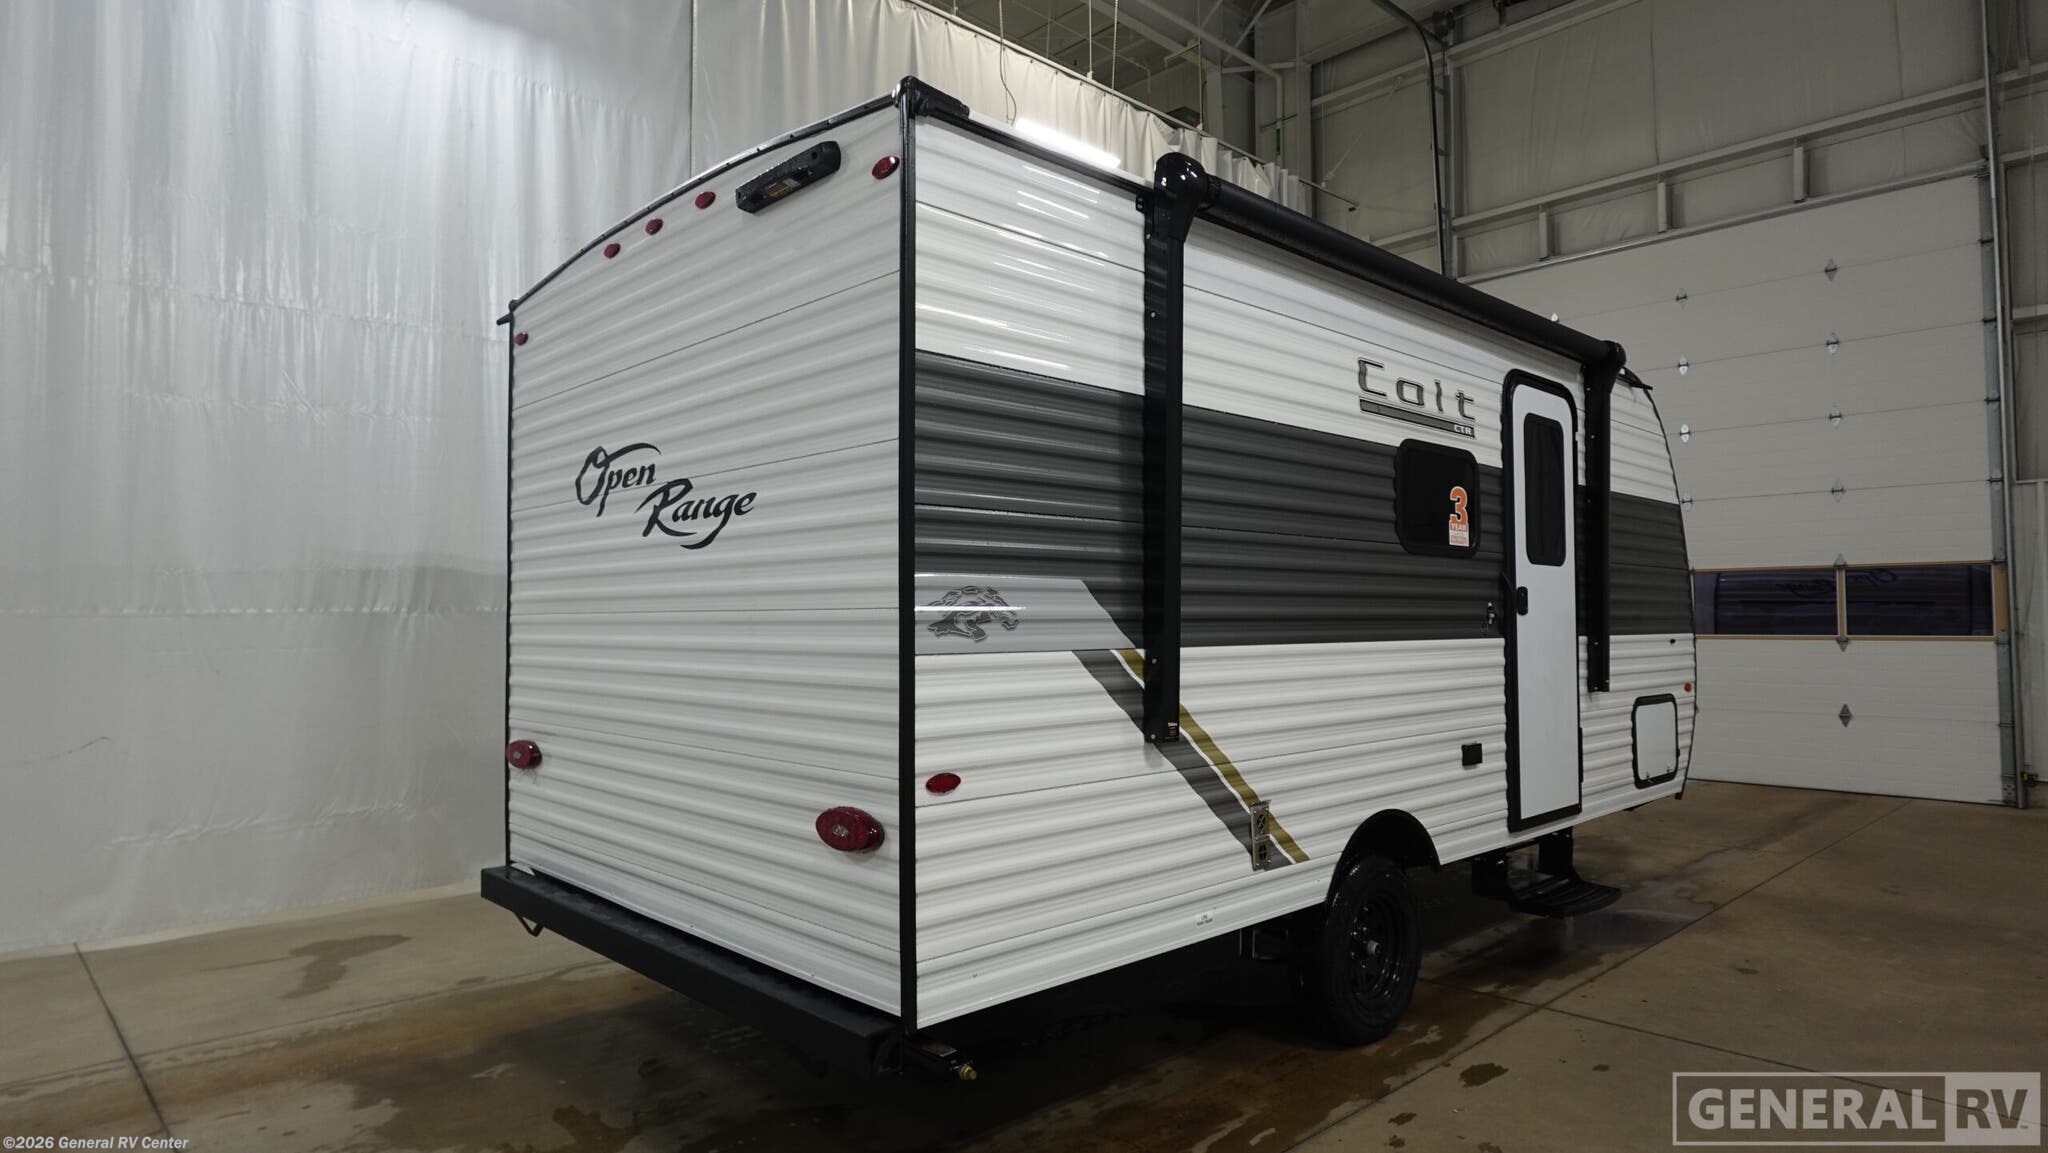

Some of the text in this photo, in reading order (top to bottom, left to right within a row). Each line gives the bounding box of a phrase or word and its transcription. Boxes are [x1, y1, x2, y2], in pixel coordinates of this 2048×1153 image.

[1358, 357, 1476, 421] Colt
[1454, 424, 1473, 436] CTR
[575, 442, 662, 518] Open
[1450, 486, 1468, 524] 3
[635, 478, 757, 550] Range
